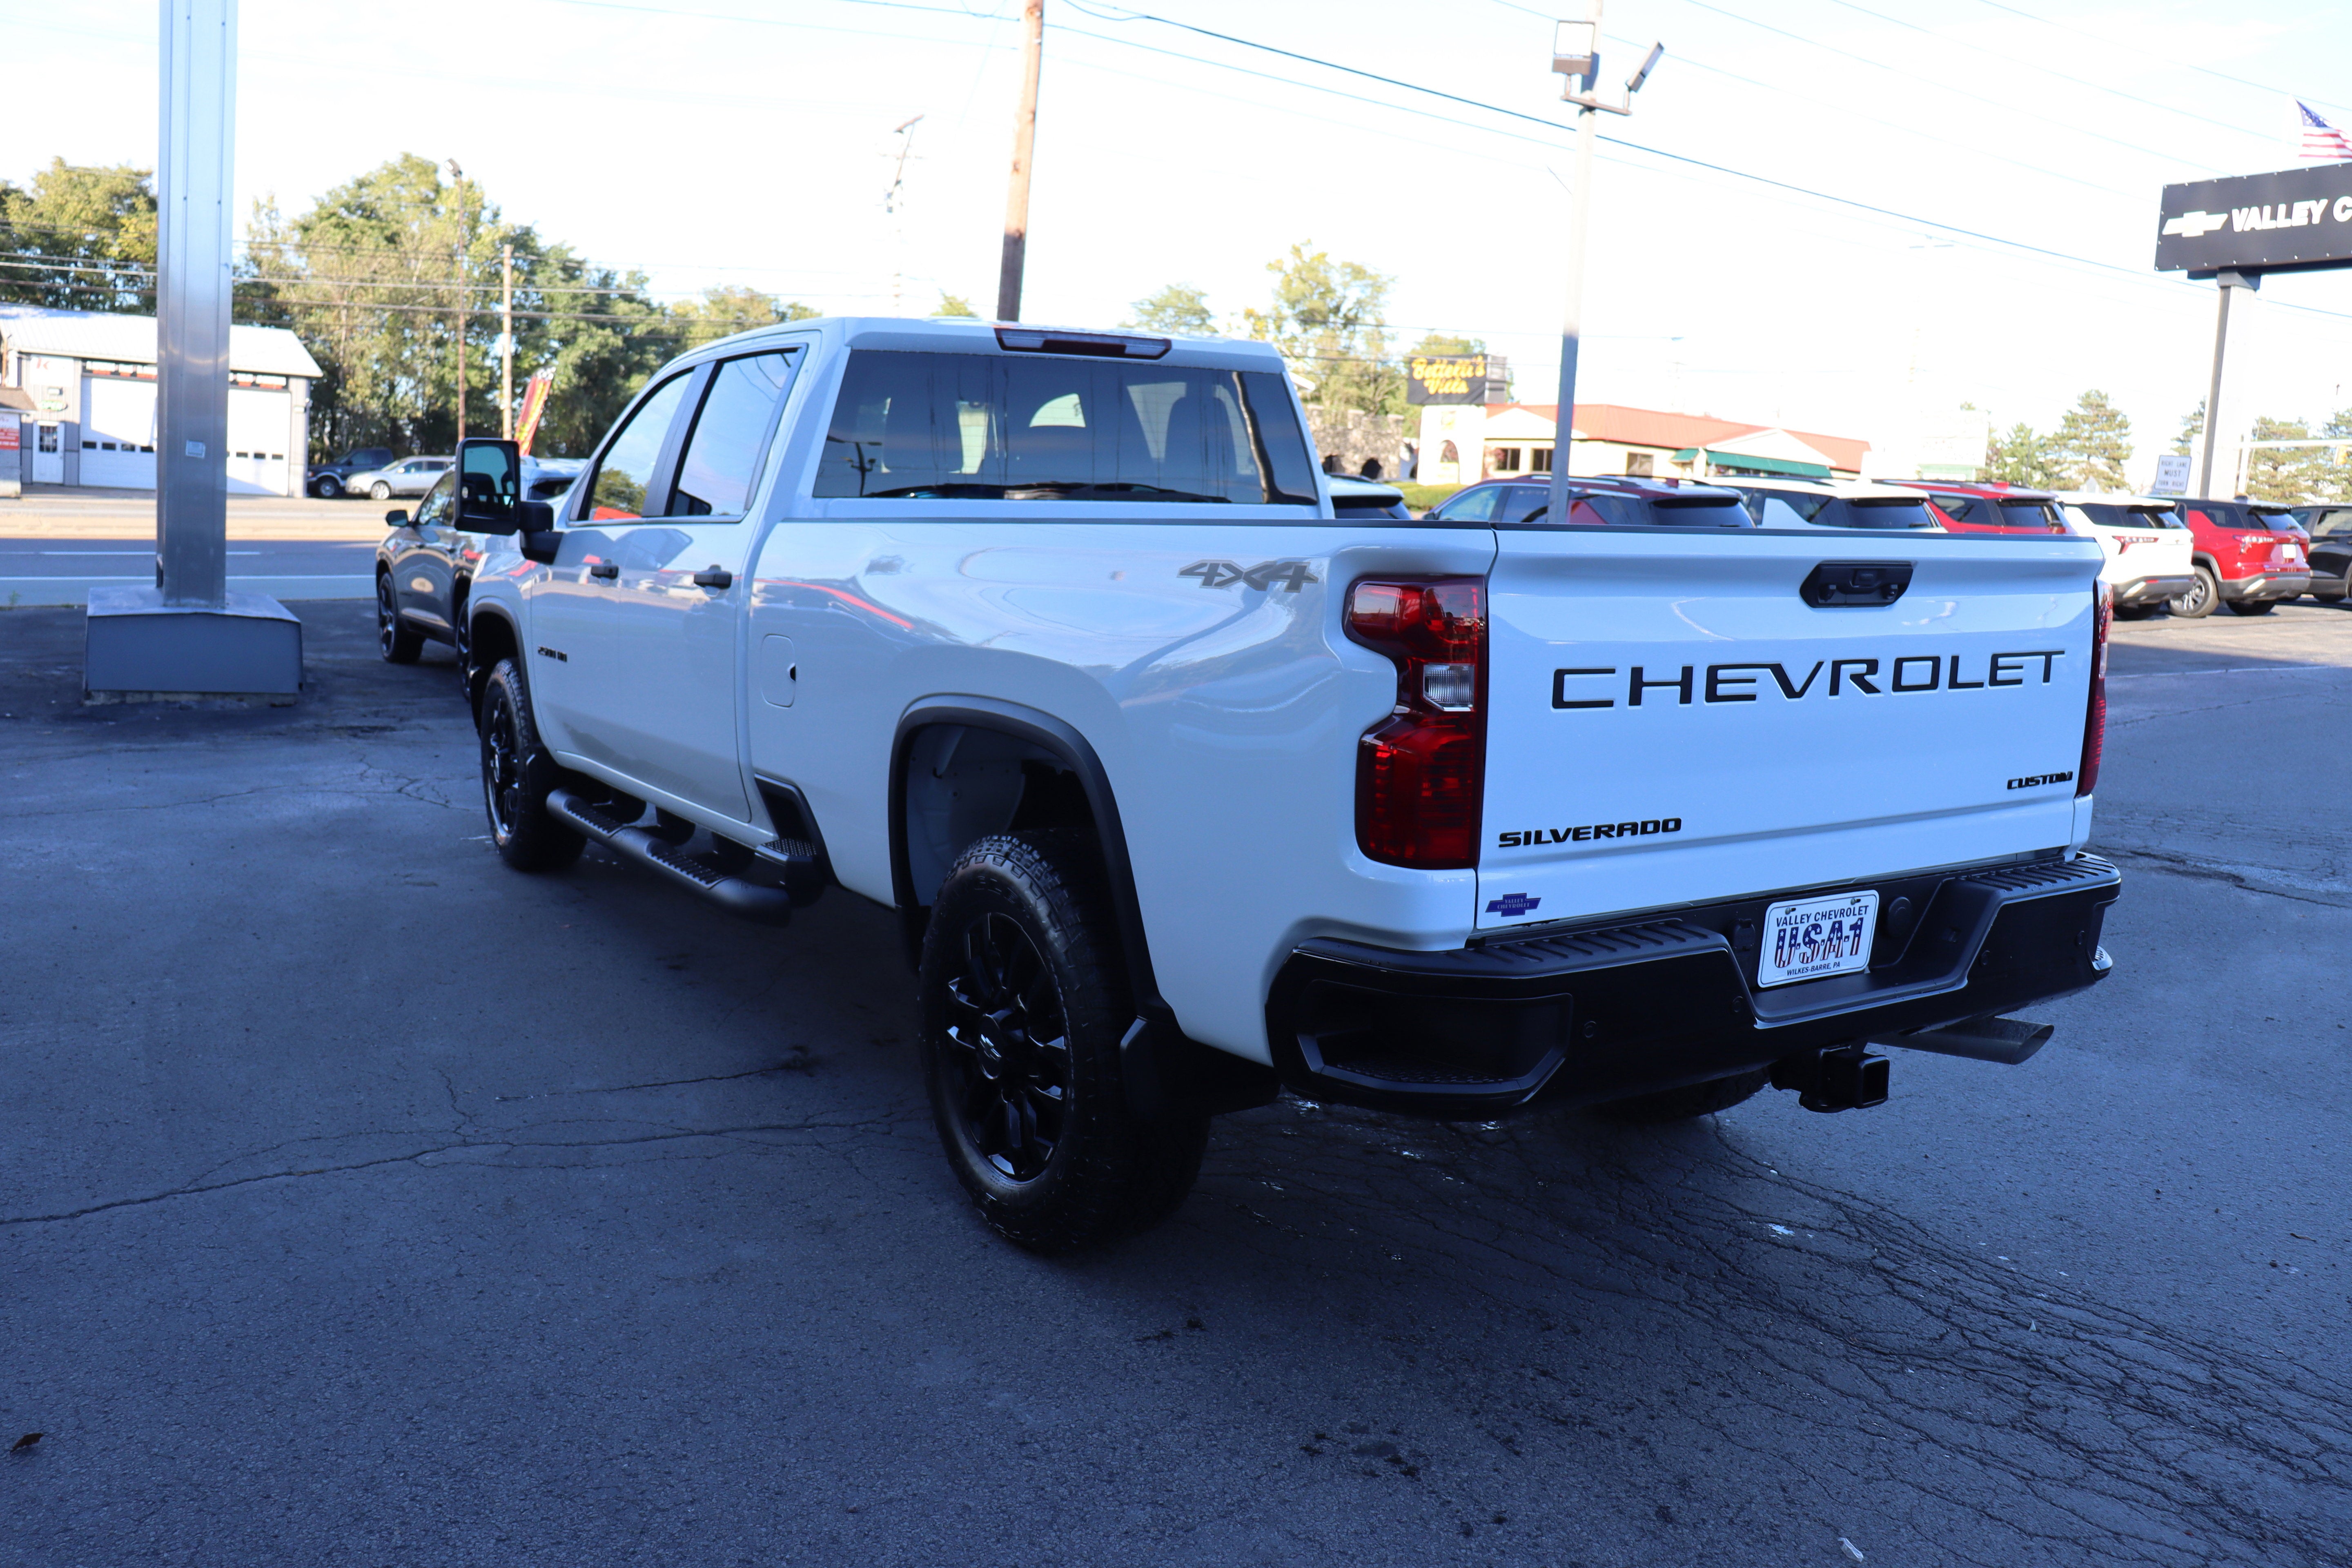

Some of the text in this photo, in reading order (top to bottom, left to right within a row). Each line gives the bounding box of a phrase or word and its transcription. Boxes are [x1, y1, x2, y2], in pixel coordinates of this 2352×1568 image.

[2232, 199, 2328, 232] VALLEY
[2164, 469, 2181, 477] MUST
[1552, 650, 2065, 708] CHEVROLET
[2007, 771, 2073, 789] CUSTOM
[1499, 818, 1682, 847] SILVERADO
[1776, 905, 1869, 927] VALLEY CHEVROLET
[1787, 963, 1831, 976] WILKES-BARRE,
